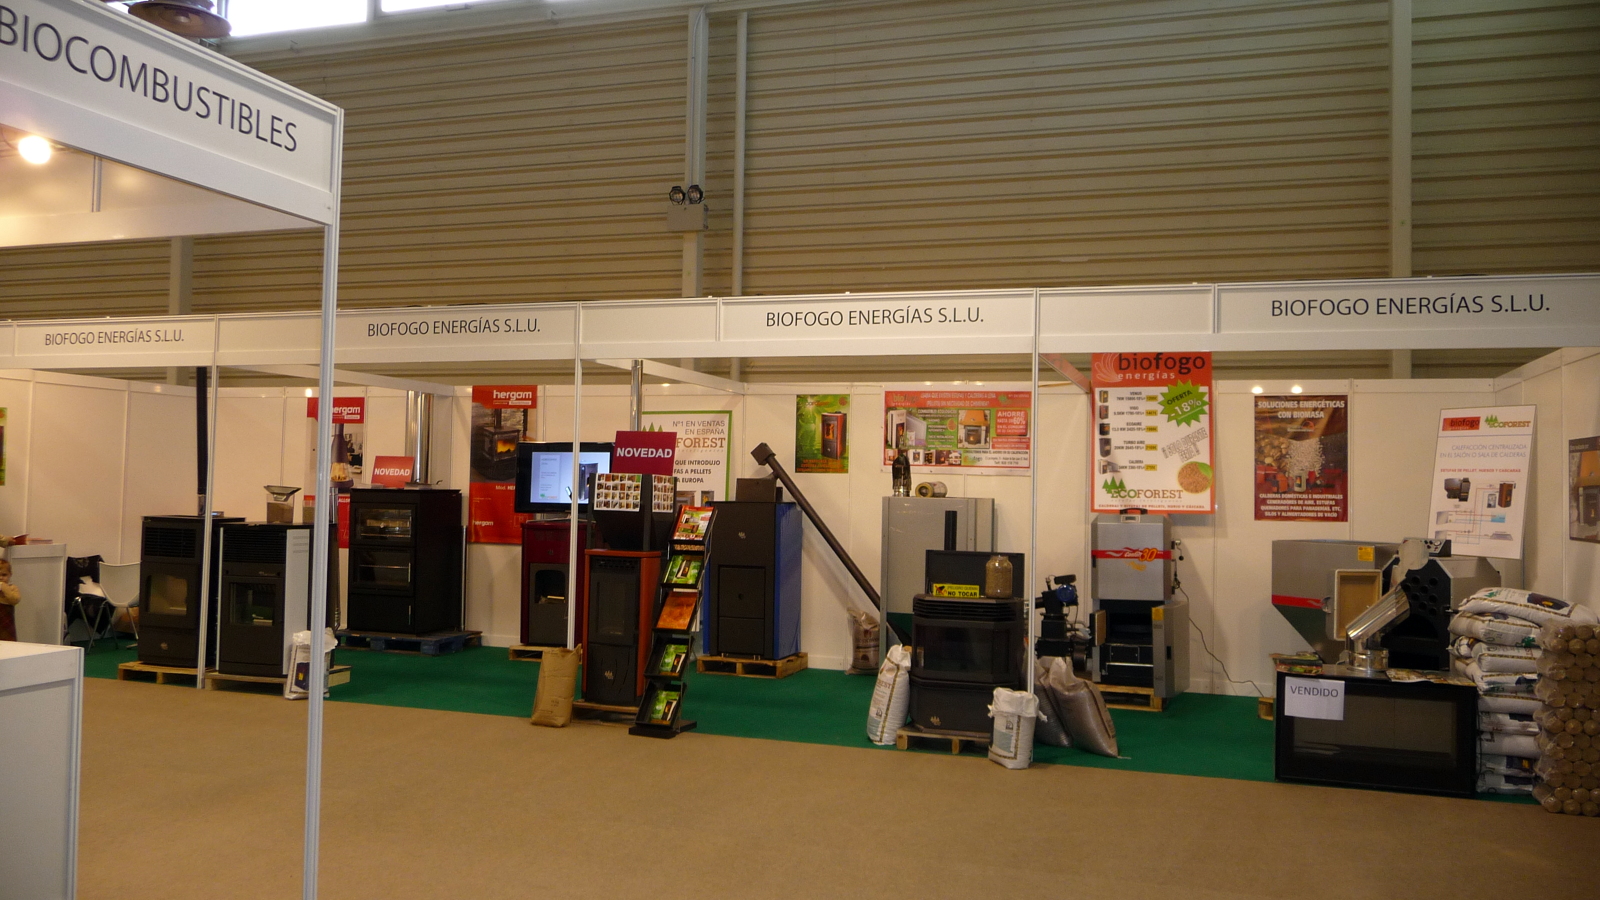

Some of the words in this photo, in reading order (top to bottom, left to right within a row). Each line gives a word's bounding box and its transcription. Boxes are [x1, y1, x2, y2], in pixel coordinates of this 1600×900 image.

[0, 6, 298, 152] BIOCOMBUSTIBLES
[1271, 298, 1369, 317] BIOFOGO
[1376, 292, 1484, 315] ENERGÍAS
[1491, 294, 1550, 313] S.L.U.
[766, 310, 844, 327] BIOFOGO
[849, 305, 933, 326] ENERGÍAS
[938, 306, 984, 323] S.L.U.
[367, 321, 429, 337] BIOFOGO
[433, 316, 500, 335] ENERGÍAS
[504, 318, 541, 333] S.L.U.
[45, 331, 95, 346] BIOFOGO
[98, 328, 152, 344] ENERGÍAS
[154, 329, 185, 343] S.L.U.
[1118, 352, 1206, 375] biofogo
[1118, 371, 1176, 381] energías
[1166, 389, 1193, 406] OFERTA
[1170, 399, 1202, 417] -18%
[1258, 400, 1299, 409] SOLUCIONES
[1300, 399, 1345, 408] ENERGÉTICAS
[1277, 411, 1292, 419] CON
[1293, 410, 1325, 419] BIOMASA
[1013, 417, 1026, 425] 60%
[1450, 417, 1480, 428] biofogo
[1489, 420, 1531, 429] ECOFOREST
[685, 428, 695, 436] EN
[697, 427, 725, 436] ESPAÑA
[616, 447, 673, 459] NOVEDAD
[1488, 443, 1527, 451] CENTRALIZADA
[374, 467, 411, 477] NOVEDAD
[1111, 489, 1184, 499] ECOFOREST
[1138, 547, 1158, 562] 30
[1290, 685, 1339, 698] VENDIDO
